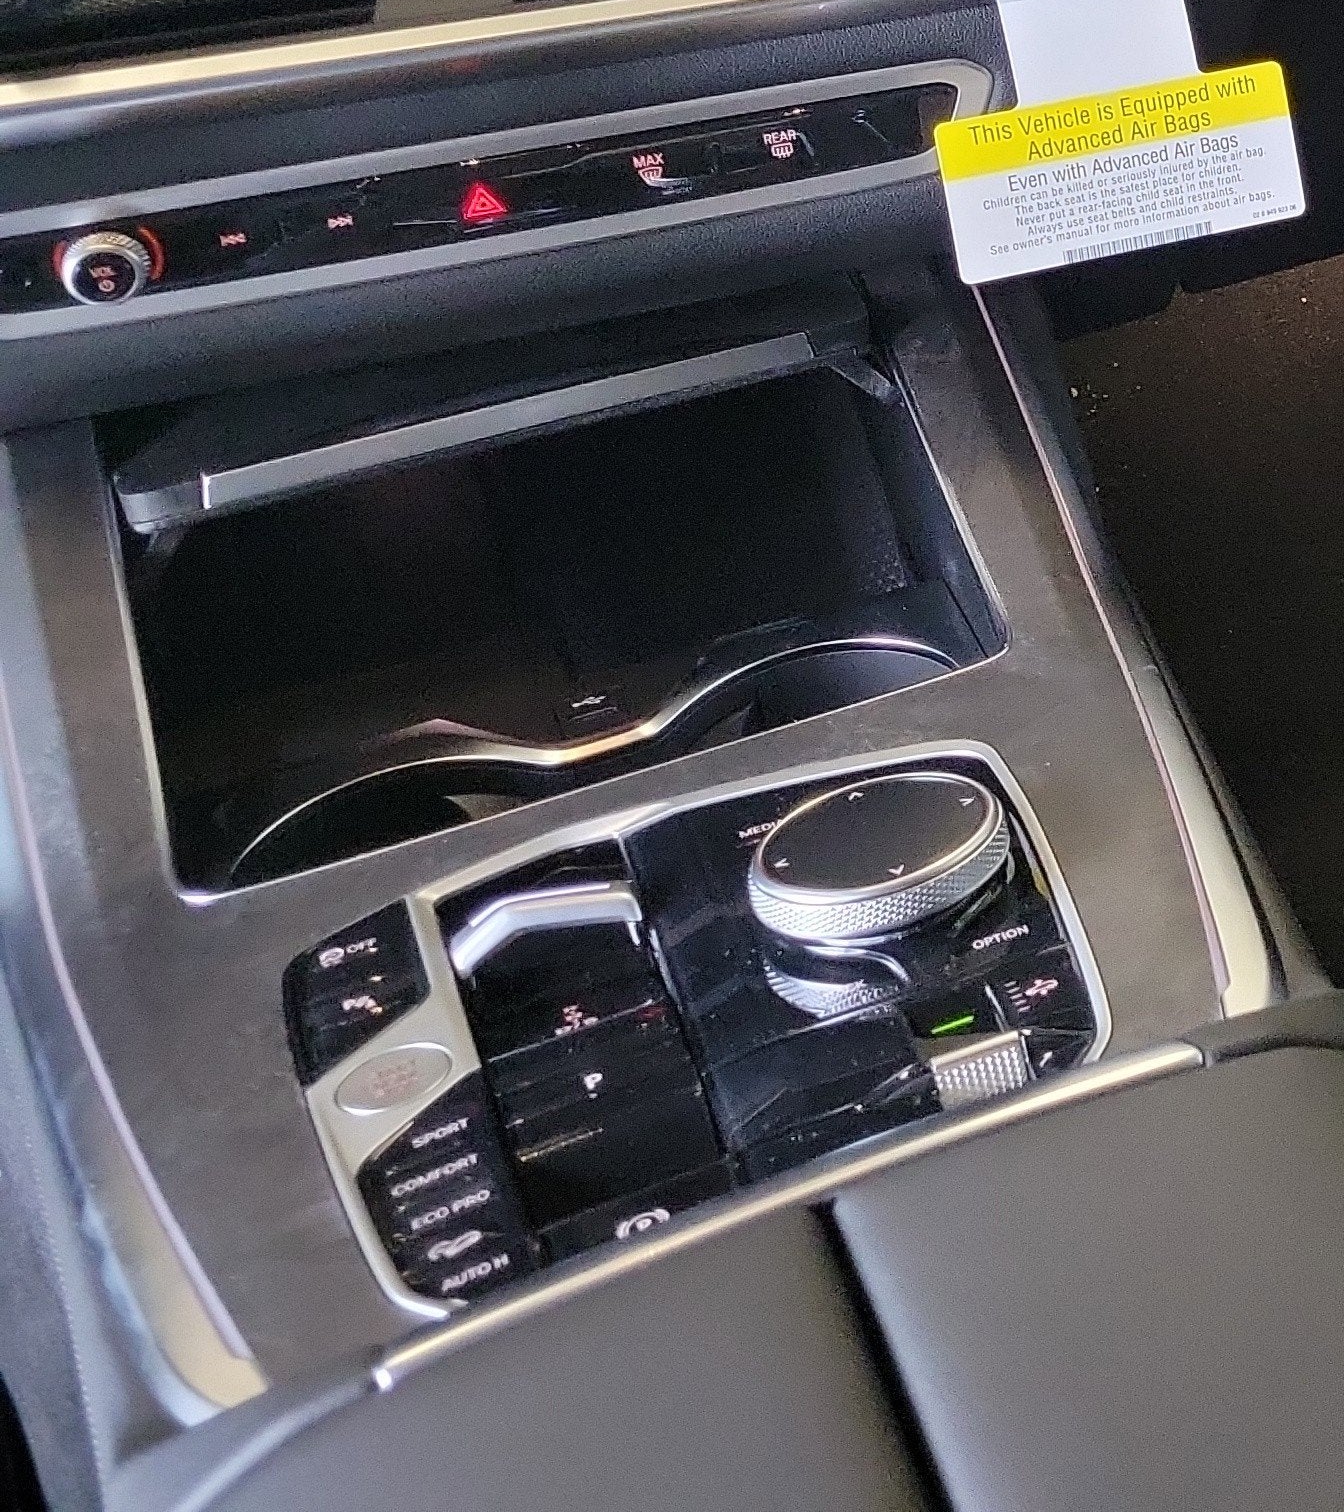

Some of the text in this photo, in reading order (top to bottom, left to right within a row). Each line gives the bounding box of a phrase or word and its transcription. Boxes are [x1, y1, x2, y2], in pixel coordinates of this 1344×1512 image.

[967, 74, 1256, 146] This Vehicle is Equipped with
[762, 129, 798, 145] REAR
[1028, 111, 1211, 161] Advanced Air Bags
[633, 152, 665, 169] MAX
[982, 146, 1266, 211] Children can be killed or seriously injured by the air bag.
[1007, 134, 1239, 192] Even with Advanced Air Bags
[1014, 163, 1242, 216] The back seat is the safest place for children.
[1015, 173, 1245, 227] Never put a rear-facing child seat in the front.
[1027, 186, 1238, 237] Always use seat belts and child restraints.
[990, 190, 1275, 256] See owner's manual for more information about air bags.
[972, 924, 1029, 950] OPTION
[584, 1072, 603, 1090] P
[412, 1116, 469, 1149] SPORT
[391, 1154, 478, 1197] COMFORT
[411, 1189, 491, 1230] ECO PRO
[441, 1261, 492, 1292] AUTO
